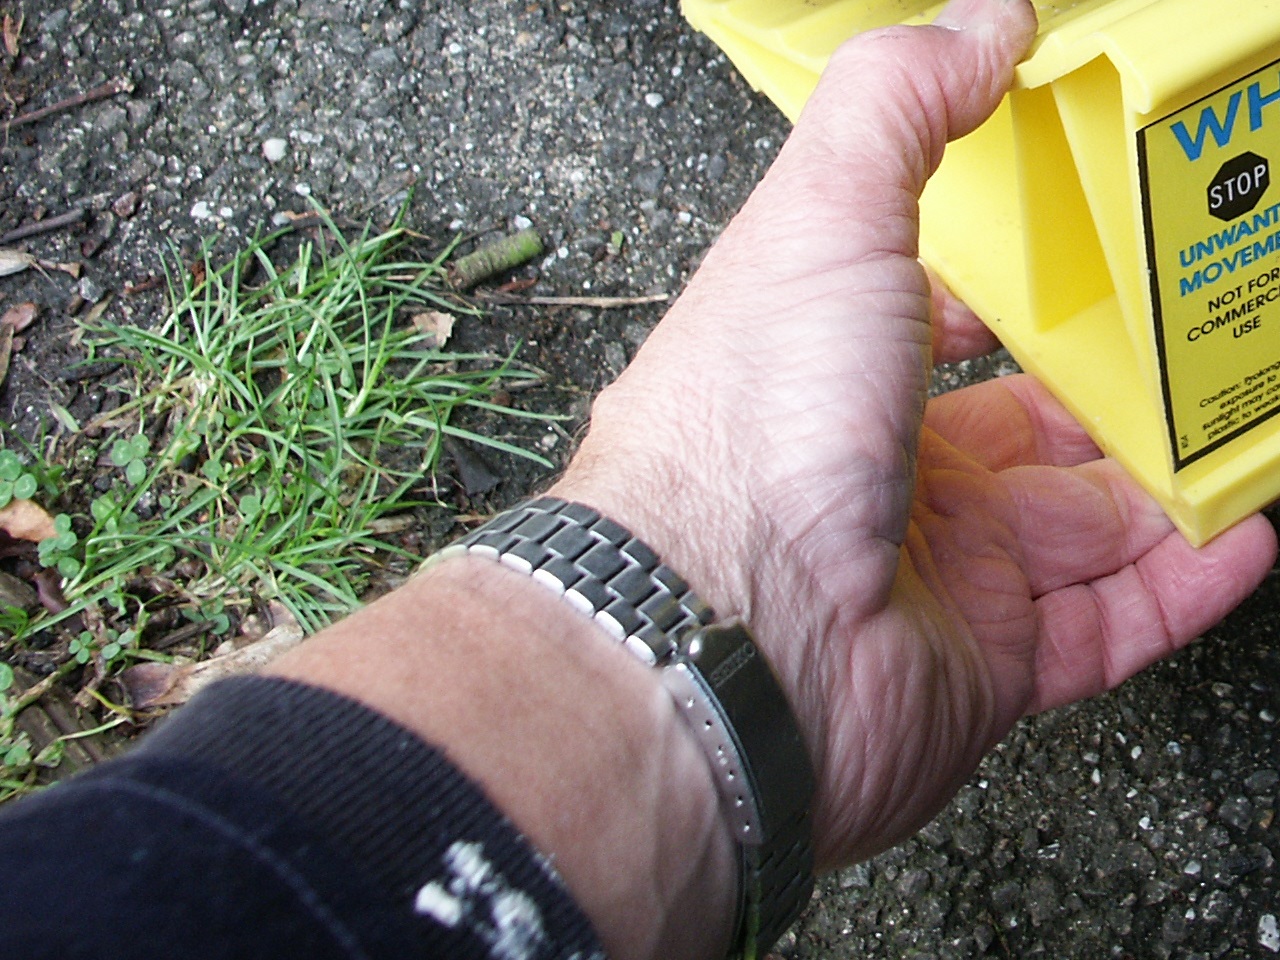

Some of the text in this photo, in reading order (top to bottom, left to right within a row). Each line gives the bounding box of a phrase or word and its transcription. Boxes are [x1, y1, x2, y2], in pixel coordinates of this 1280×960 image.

[1210, 163, 1266, 209] STOP
[1207, 266, 1280, 314] NOT FOR
[1233, 314, 1262, 339] USE
